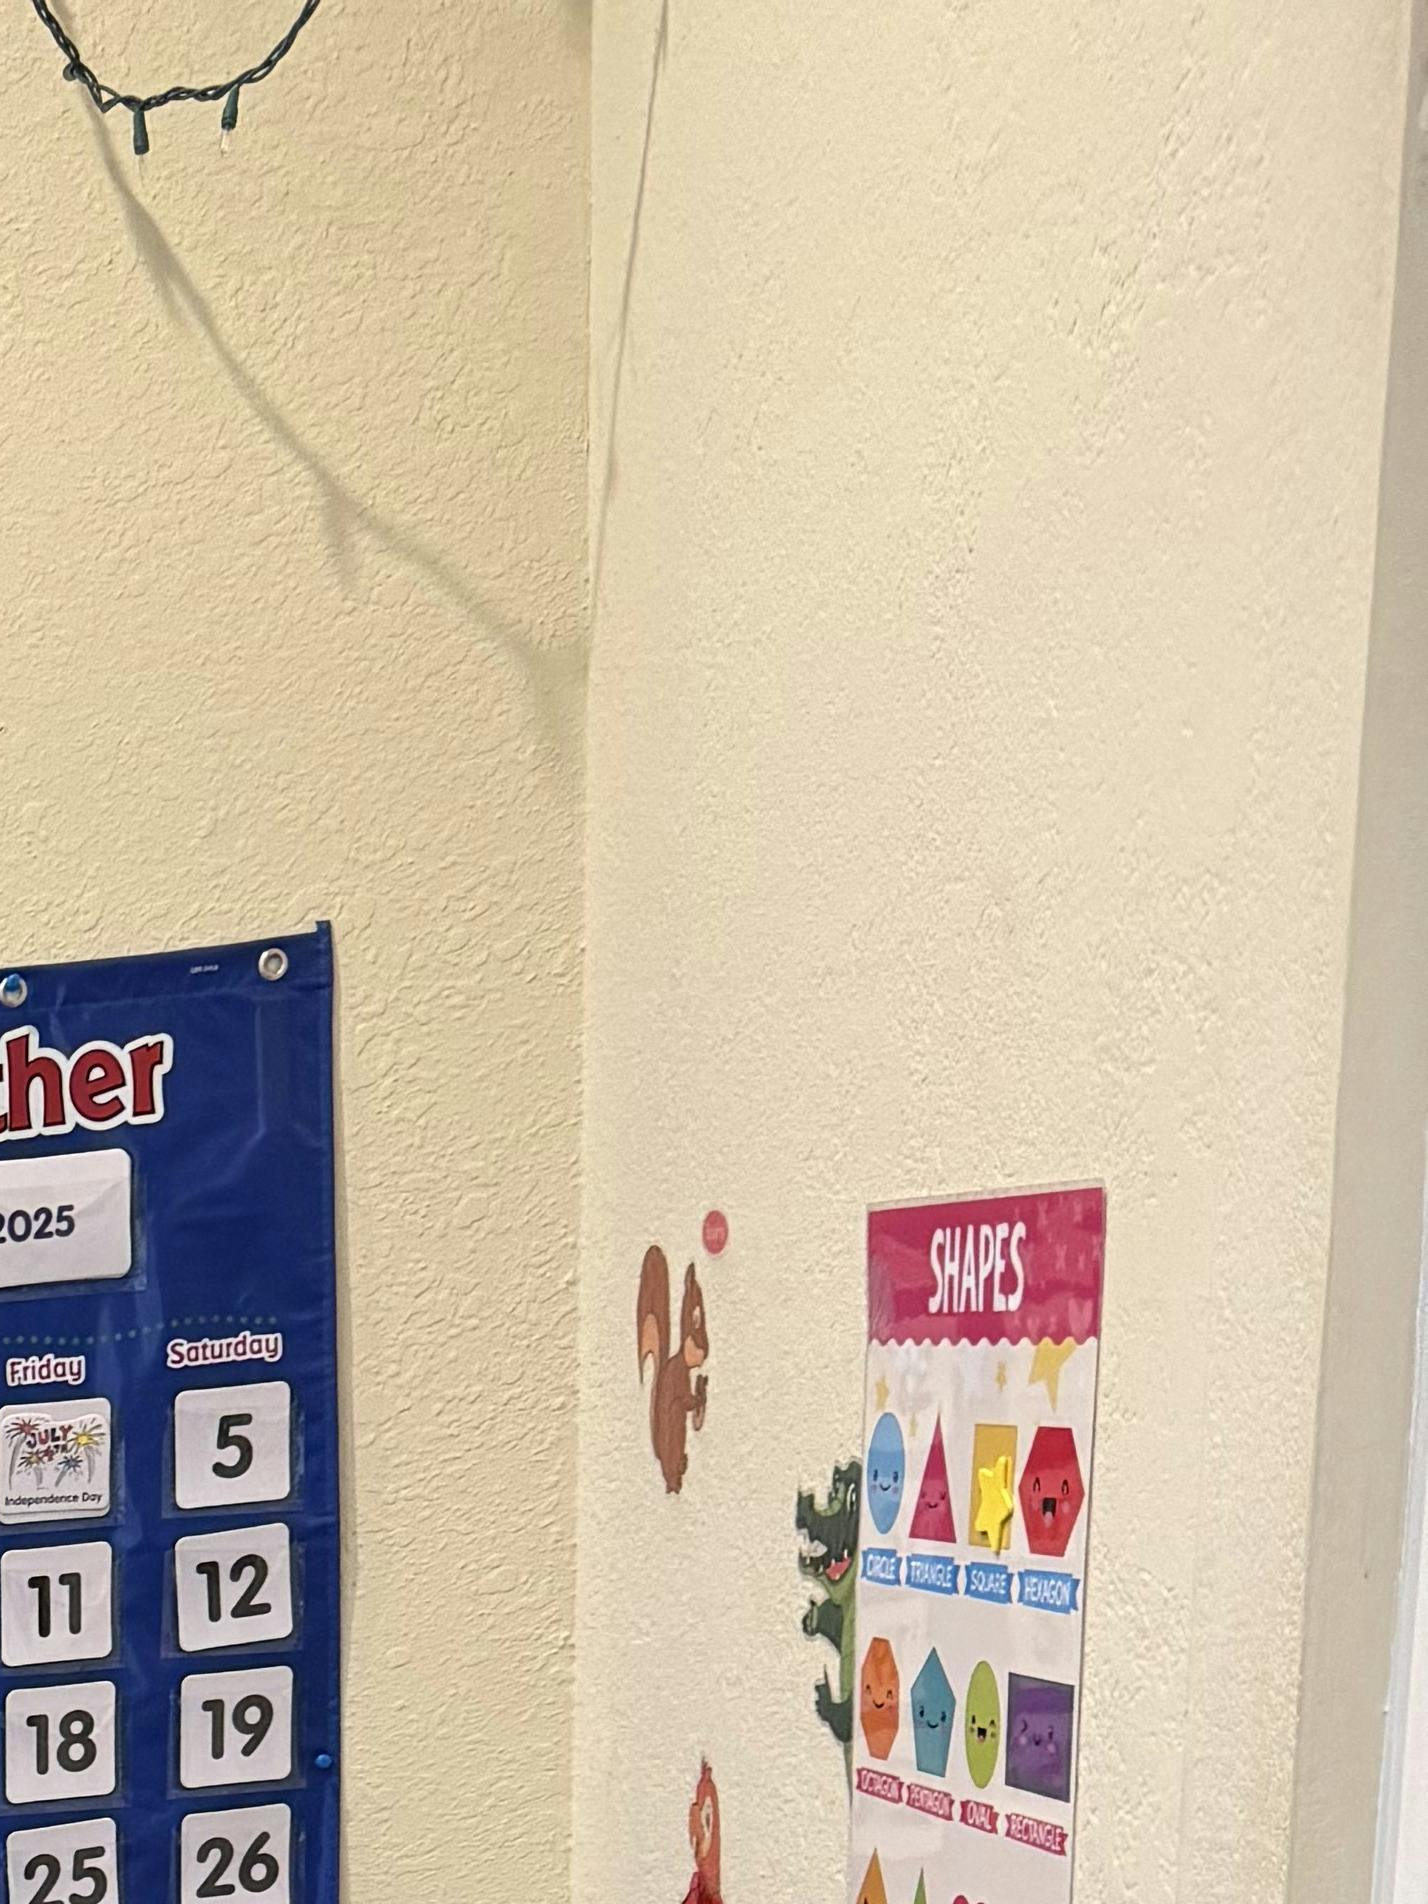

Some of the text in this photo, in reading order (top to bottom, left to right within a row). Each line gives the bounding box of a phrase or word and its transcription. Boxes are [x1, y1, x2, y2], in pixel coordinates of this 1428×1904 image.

[928, 1222, 1026, 1313] SHAPES
[7, 1355, 85, 1385] Friday
[168, 1333, 282, 1368] Saturday
[213, 1414, 253, 1478] 5
[5, 1492, 102, 1508] Independence Day
[28, 1573, 81, 1637] 11
[196, 1554, 271, 1622] 12
[910, 1558, 952, 1588] TRIANGLE
[971, 1567, 1007, 1596] SQUARE
[1024, 1575, 1071, 1607] HEXAGON
[26, 1710, 96, 1775] 18
[202, 1695, 273, 1759] 19
[197, 1832, 279, 1898] 26
